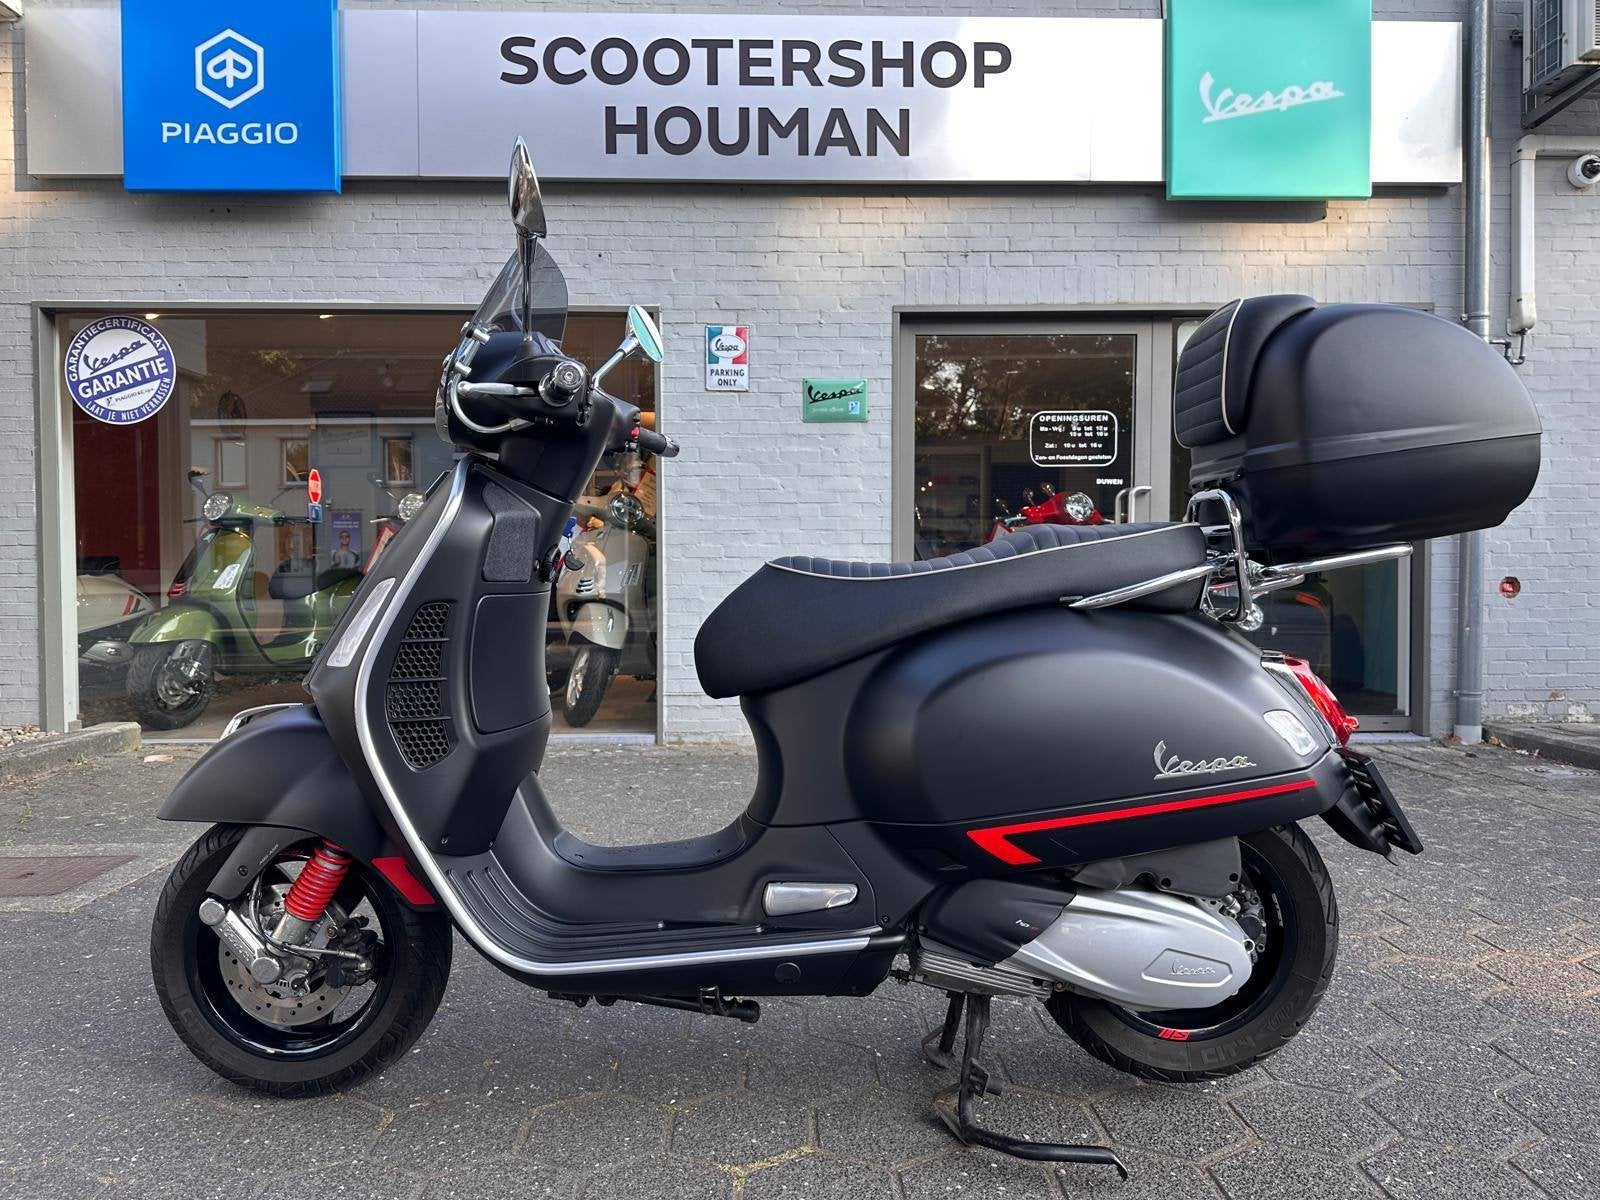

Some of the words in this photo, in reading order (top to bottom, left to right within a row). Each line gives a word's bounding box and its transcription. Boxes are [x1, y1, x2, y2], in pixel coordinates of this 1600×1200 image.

[499, 36, 1012, 88] SCOOTERSHOP
[1199, 71, 1345, 124] Vespa
[161, 122, 298, 145] PIAGGIO
[604, 105, 910, 157] HOUMAN
[69, 318, 168, 382] GARANTIECERTIFICAAT
[83, 340, 147, 375] Vespa
[714, 338, 741, 352] Vespa
[78, 357, 169, 399] GARANTIE
[710, 368, 745, 377] PARKING
[717, 378, 738, 387] ONLY
[85, 401, 104, 417] LAAT
[107, 410, 117, 421] JE
[121, 409, 140, 421] NIET
[140, 377, 171, 415] VERRASSEN
[807, 385, 864, 404] Vespa
[1039, 414, 1109, 422] OPENINGSUREN
[1153, 740, 1257, 780] Vespa
[1168, 958, 1217, 977] Vespa
